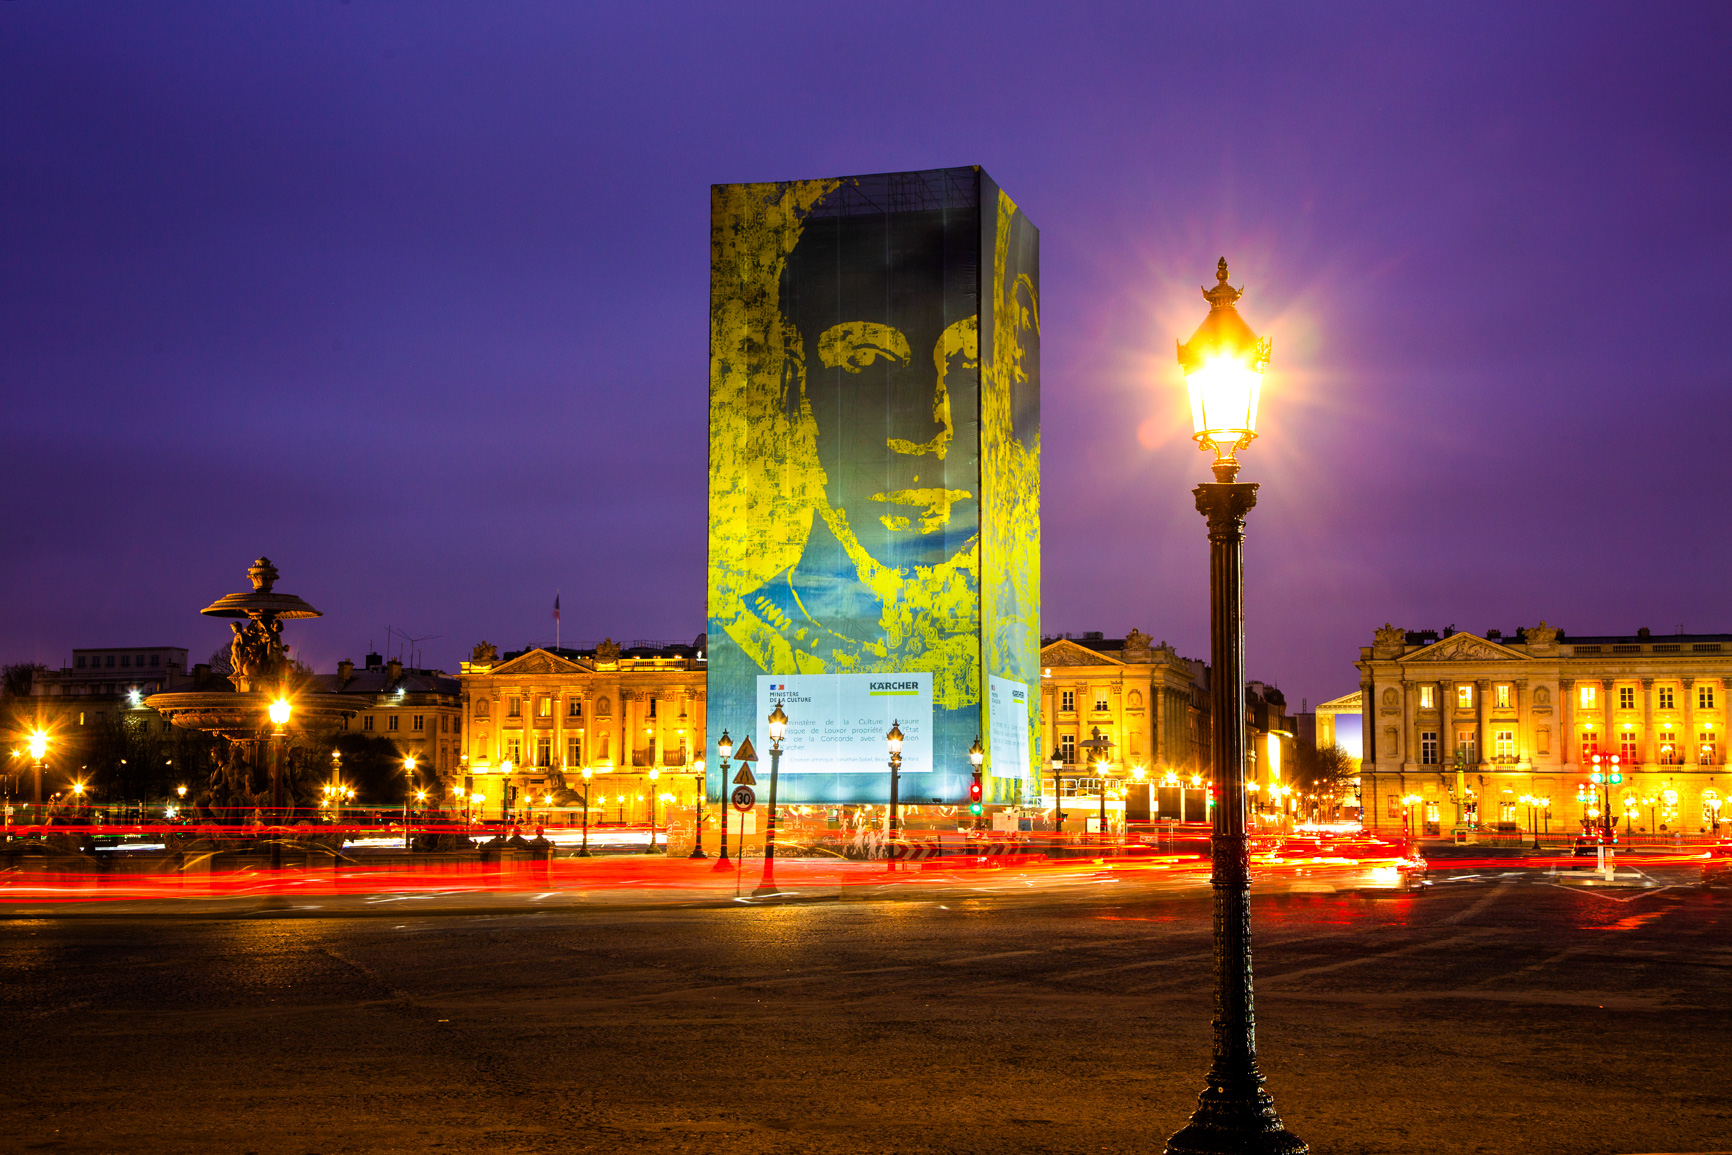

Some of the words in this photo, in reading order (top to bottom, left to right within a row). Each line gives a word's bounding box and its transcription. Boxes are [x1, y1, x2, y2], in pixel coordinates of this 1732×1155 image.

[869, 681, 919, 690] KÄRCHER
[851, 726, 883, 734] propriété
[736, 792, 751, 805] 30
